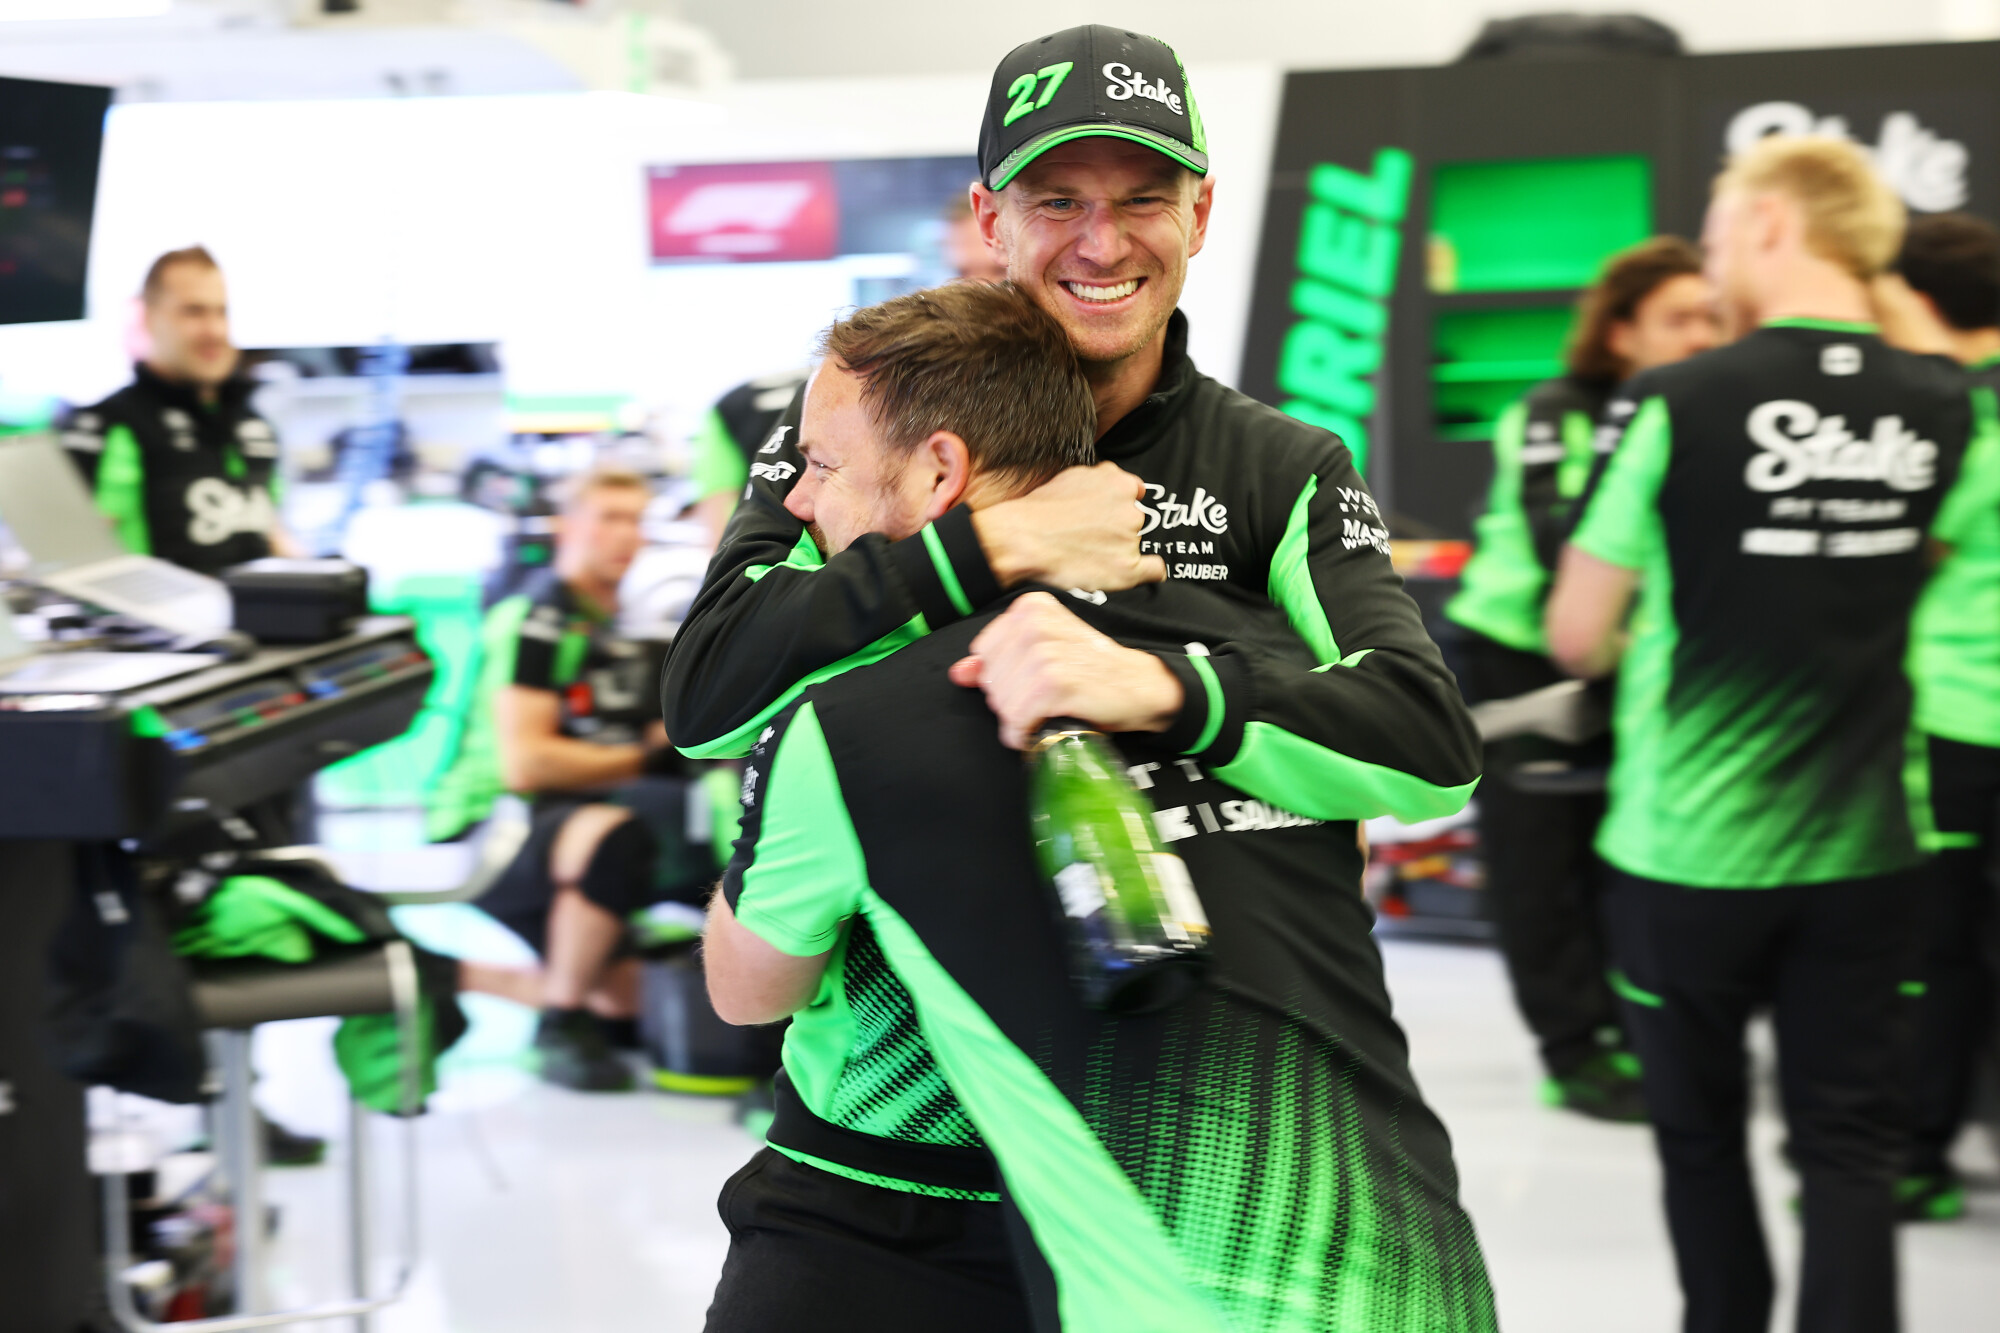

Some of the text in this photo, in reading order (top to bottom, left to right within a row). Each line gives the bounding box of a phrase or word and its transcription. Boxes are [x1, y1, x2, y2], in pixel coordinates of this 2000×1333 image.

[1003, 61, 1074, 127] 27
[1101, 62, 1183, 116] Stake
[1744, 398, 1939, 492] Stake
[1133, 482, 1228, 537] Stake
[1165, 541, 1214, 555] TEAM
[1173, 563, 1229, 581] SAUBER
